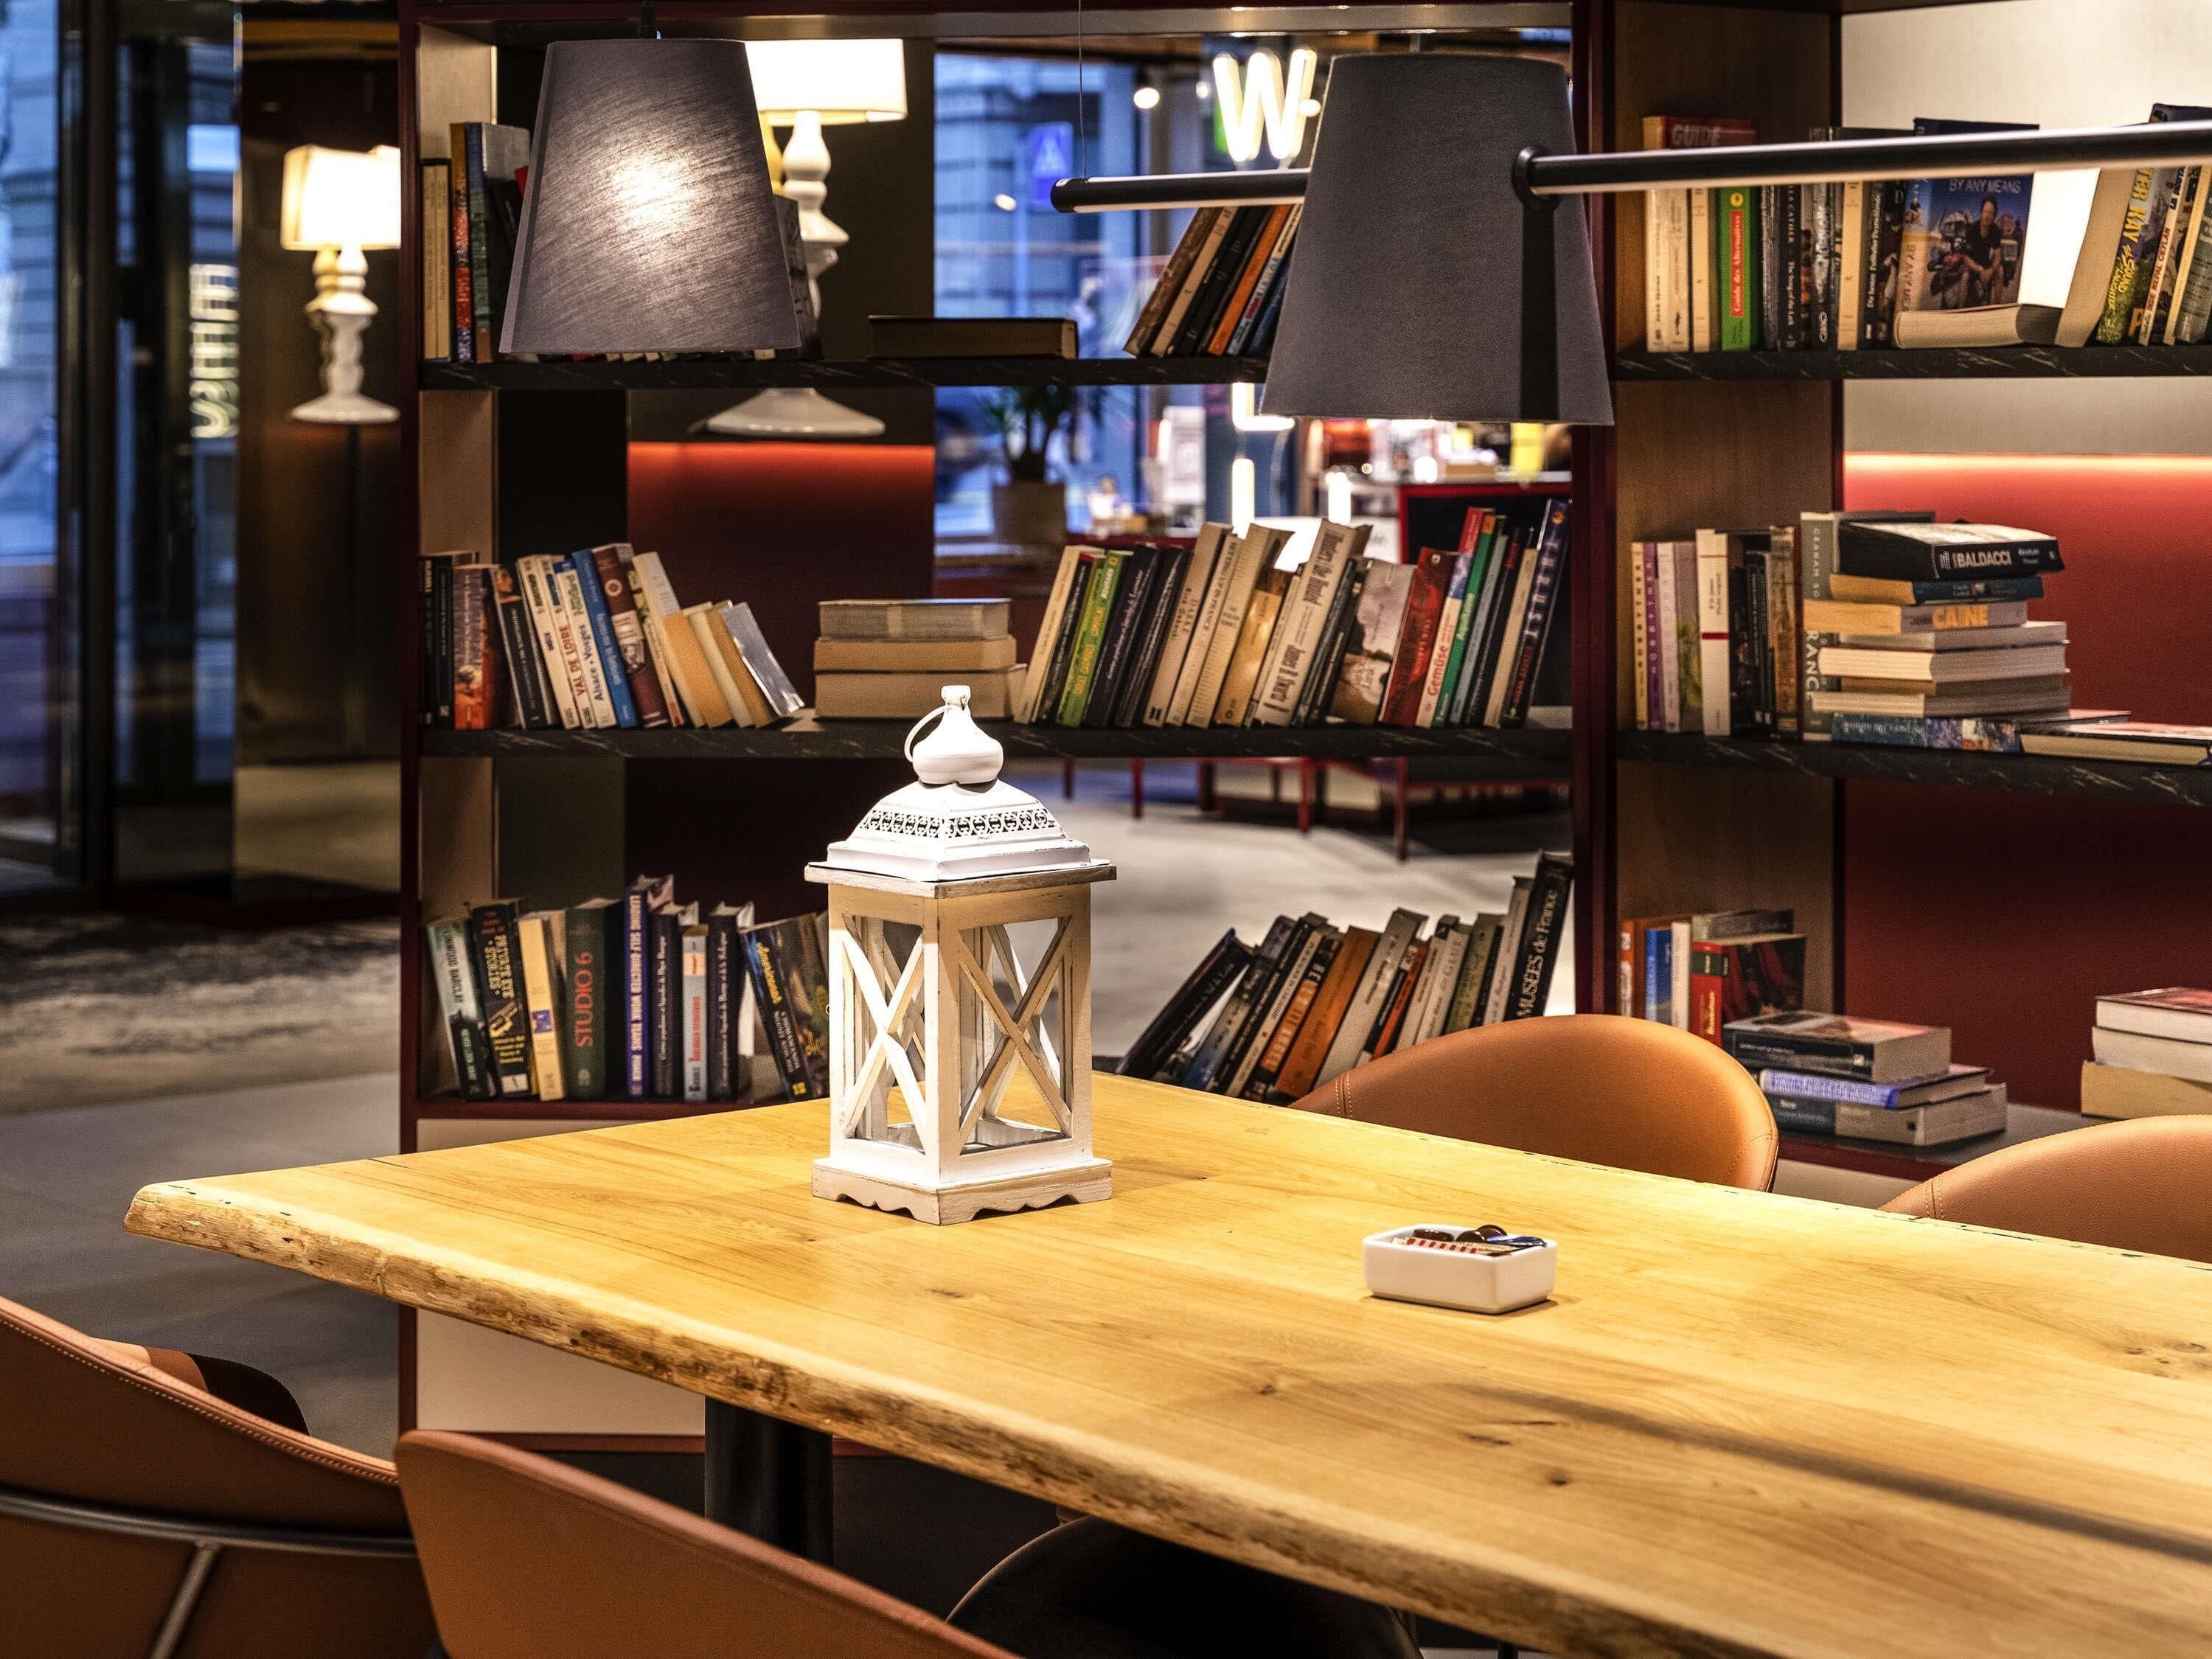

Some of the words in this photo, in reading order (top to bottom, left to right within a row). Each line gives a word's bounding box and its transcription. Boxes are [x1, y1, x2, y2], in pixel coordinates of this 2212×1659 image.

[1950, 179, 1963, 192] BY
[1964, 179, 1984, 192] ANY
[1986, 179, 2020, 193] MEANS
[2121, 204, 2147, 244] KAY
[2104, 268, 2122, 310] LAUGHTER
[2115, 255, 2138, 294] SOUND
[1956, 549, 2012, 569] BALDACCI
[1933, 603, 1989, 628] CAINE
[558, 624, 576, 655] LOIRE
[575, 623, 595, 660] Vosges
[567, 659, 580, 672] DE
[1425, 644, 1449, 697] Gemüse
[571, 675, 585, 695] VAL
[586, 667, 605, 702] Alsace
[1534, 887, 1559, 934] France
[494, 934, 512, 978] PRIVATE
[575, 950, 593, 965] 6
[1530, 933, 1548, 954] de
[484, 945, 501, 990] STORIES
[447, 968, 465, 1004] BARCLAY
[500, 978, 515, 998] EYE
[572, 968, 594, 1048] STUDIO
